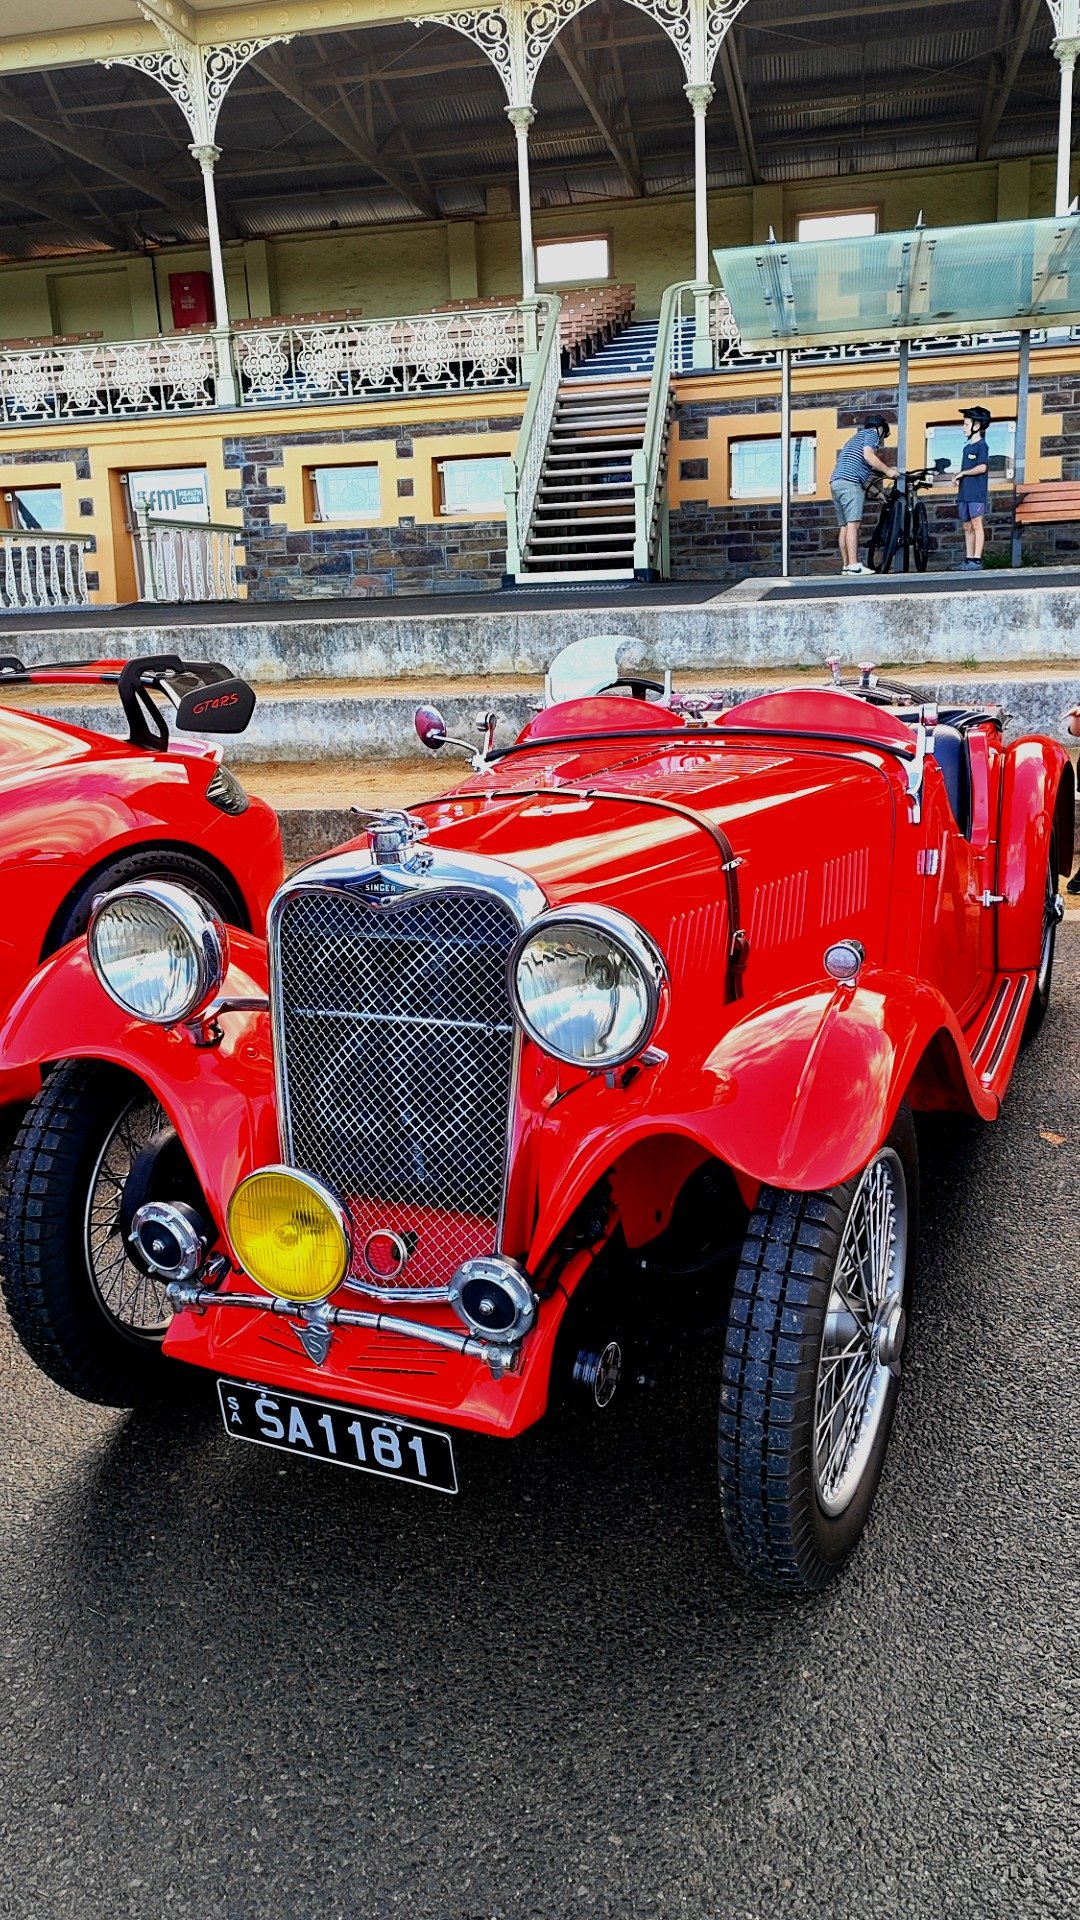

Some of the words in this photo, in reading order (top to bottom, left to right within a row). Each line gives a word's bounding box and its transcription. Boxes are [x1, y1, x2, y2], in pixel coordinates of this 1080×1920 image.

[146, 490, 177, 511] fm
[178, 489, 202, 497] HEALTH
[180, 495, 201, 503] CLUBS
[193, 693, 239, 714] GT4RS
[364, 883, 397, 892] SINGER
[254, 1399, 428, 1477] SA1181
